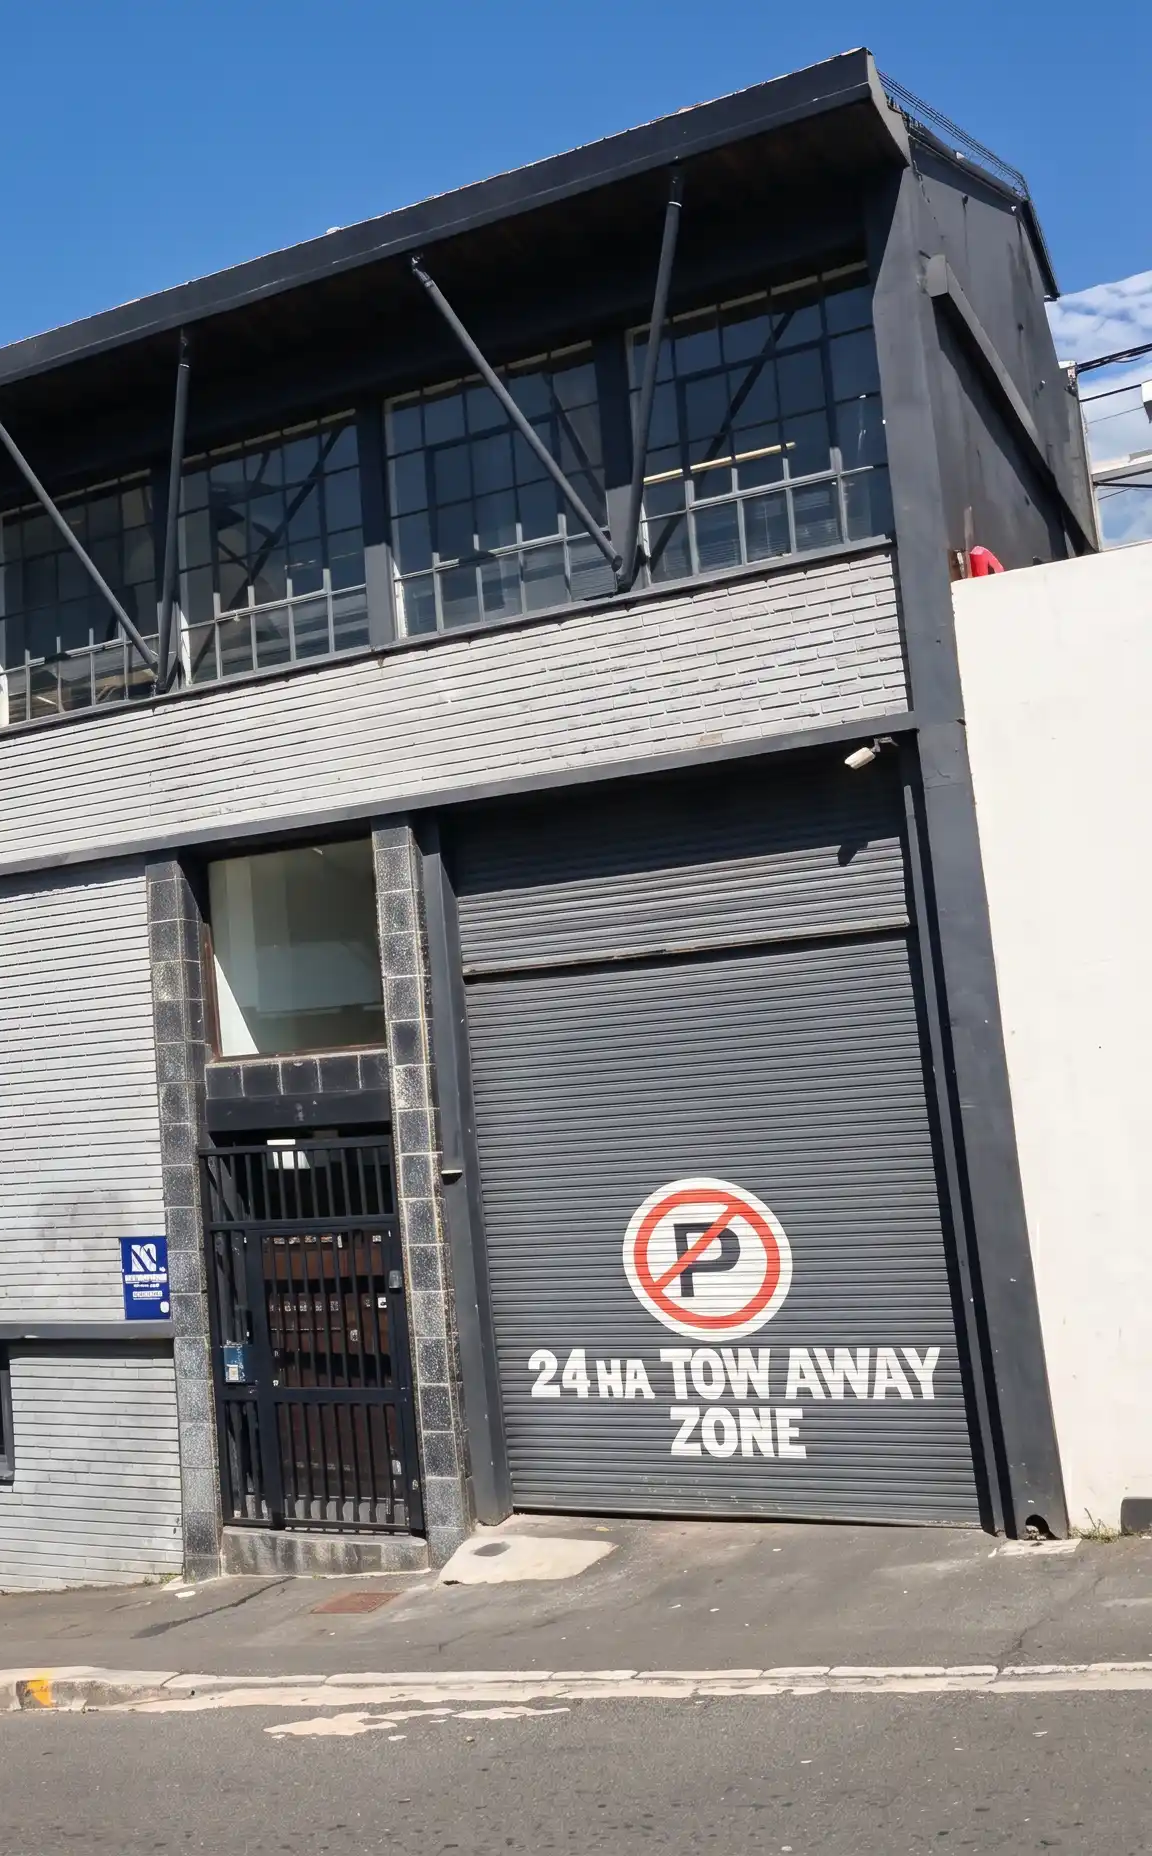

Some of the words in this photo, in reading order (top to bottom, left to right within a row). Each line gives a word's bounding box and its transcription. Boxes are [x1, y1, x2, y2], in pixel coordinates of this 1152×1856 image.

[673, 1222, 741, 1298] P
[527, 1349, 591, 1399] 24
[659, 1347, 771, 1400] TOW
[785, 1346, 941, 1400] AWAY
[670, 1407, 807, 1460] ZONE
